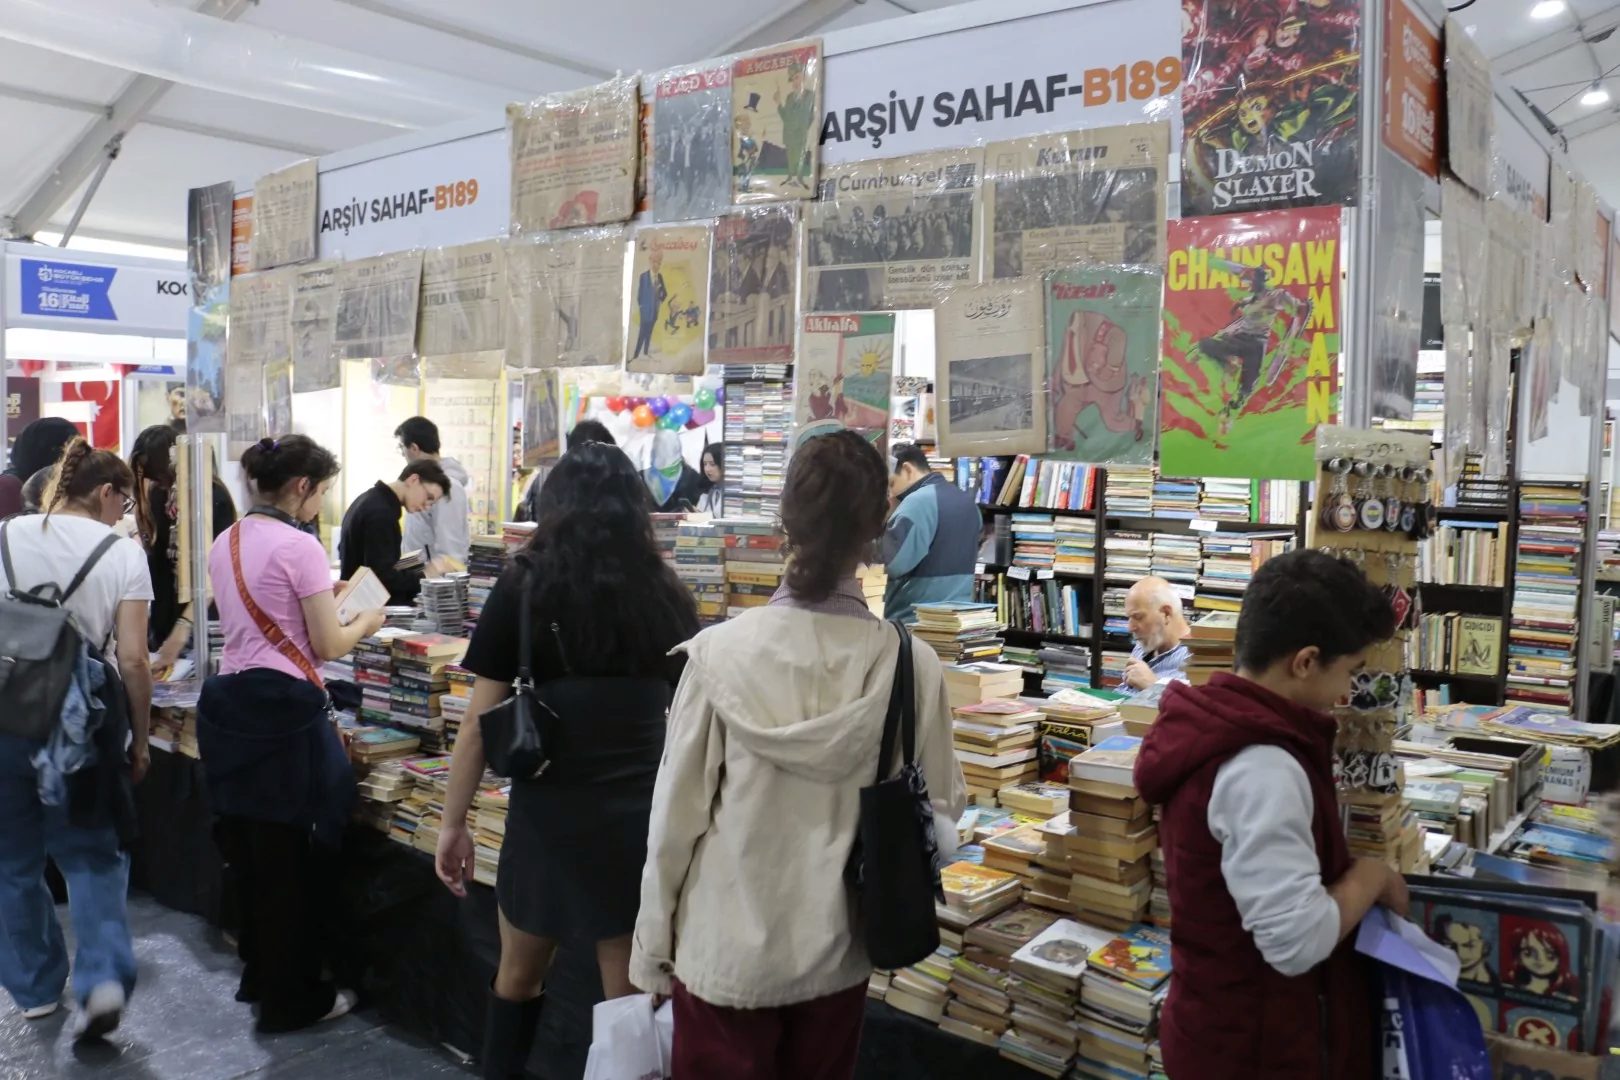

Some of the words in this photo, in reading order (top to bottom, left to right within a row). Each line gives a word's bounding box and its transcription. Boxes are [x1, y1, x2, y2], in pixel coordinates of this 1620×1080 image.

[819, 90, 925, 149] ARŞİV
[932, 56, 1182, 128] SAHAF-B189
[1214, 139, 1317, 179] DEMON
[320, 196, 368, 236] ARŞİV
[370, 178, 479, 224] SAHAF-B189
[1211, 168, 1323, 210] SLAYER
[1167, 239, 1337, 292] CHAINSAW
[38, 292, 59, 308] 16
[1306, 286, 1334, 424] MAN
[1538, 766, 1574, 777] EMIUM
[1538, 776, 1574, 787] NANAS
